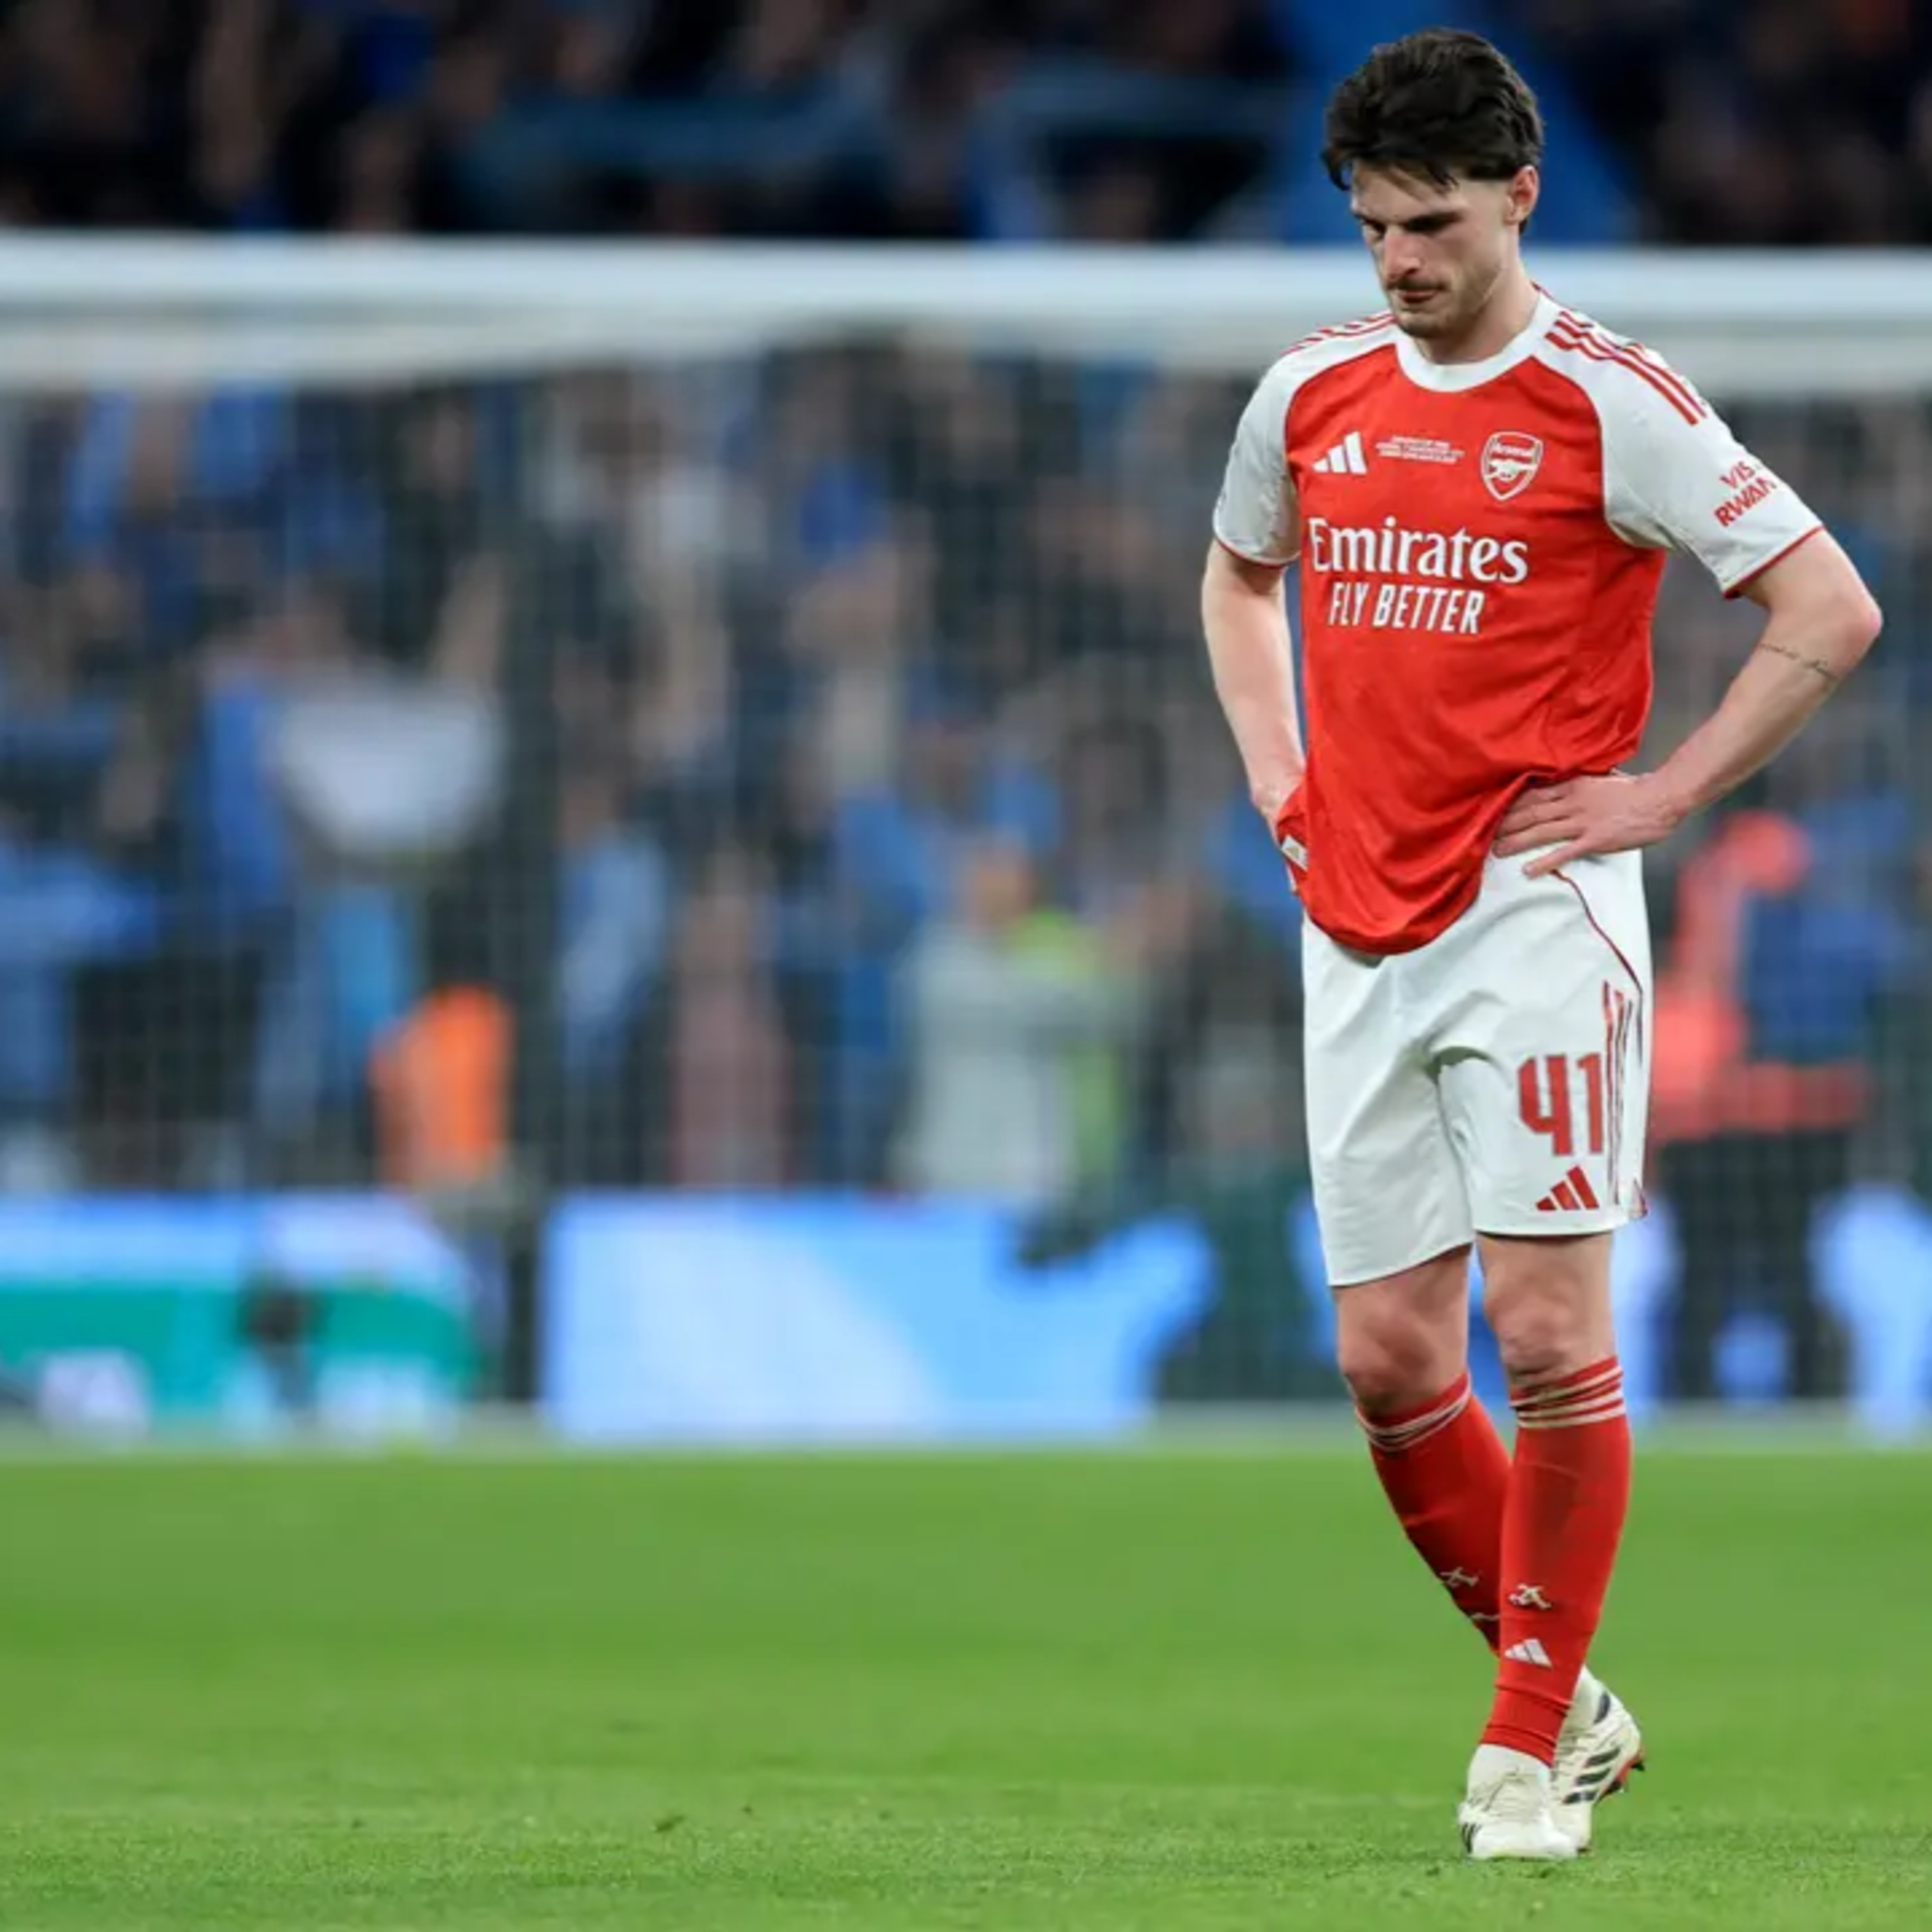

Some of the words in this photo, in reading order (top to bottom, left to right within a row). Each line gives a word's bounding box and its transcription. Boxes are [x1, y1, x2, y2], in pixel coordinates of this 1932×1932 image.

[1719, 461, 1762, 489] VIS
[1309, 516, 1528, 583] Emirates
[1329, 582, 1369, 626] FLY
[1372, 584, 1484, 634] BETTER
[1517, 1052, 1603, 1156] 41
